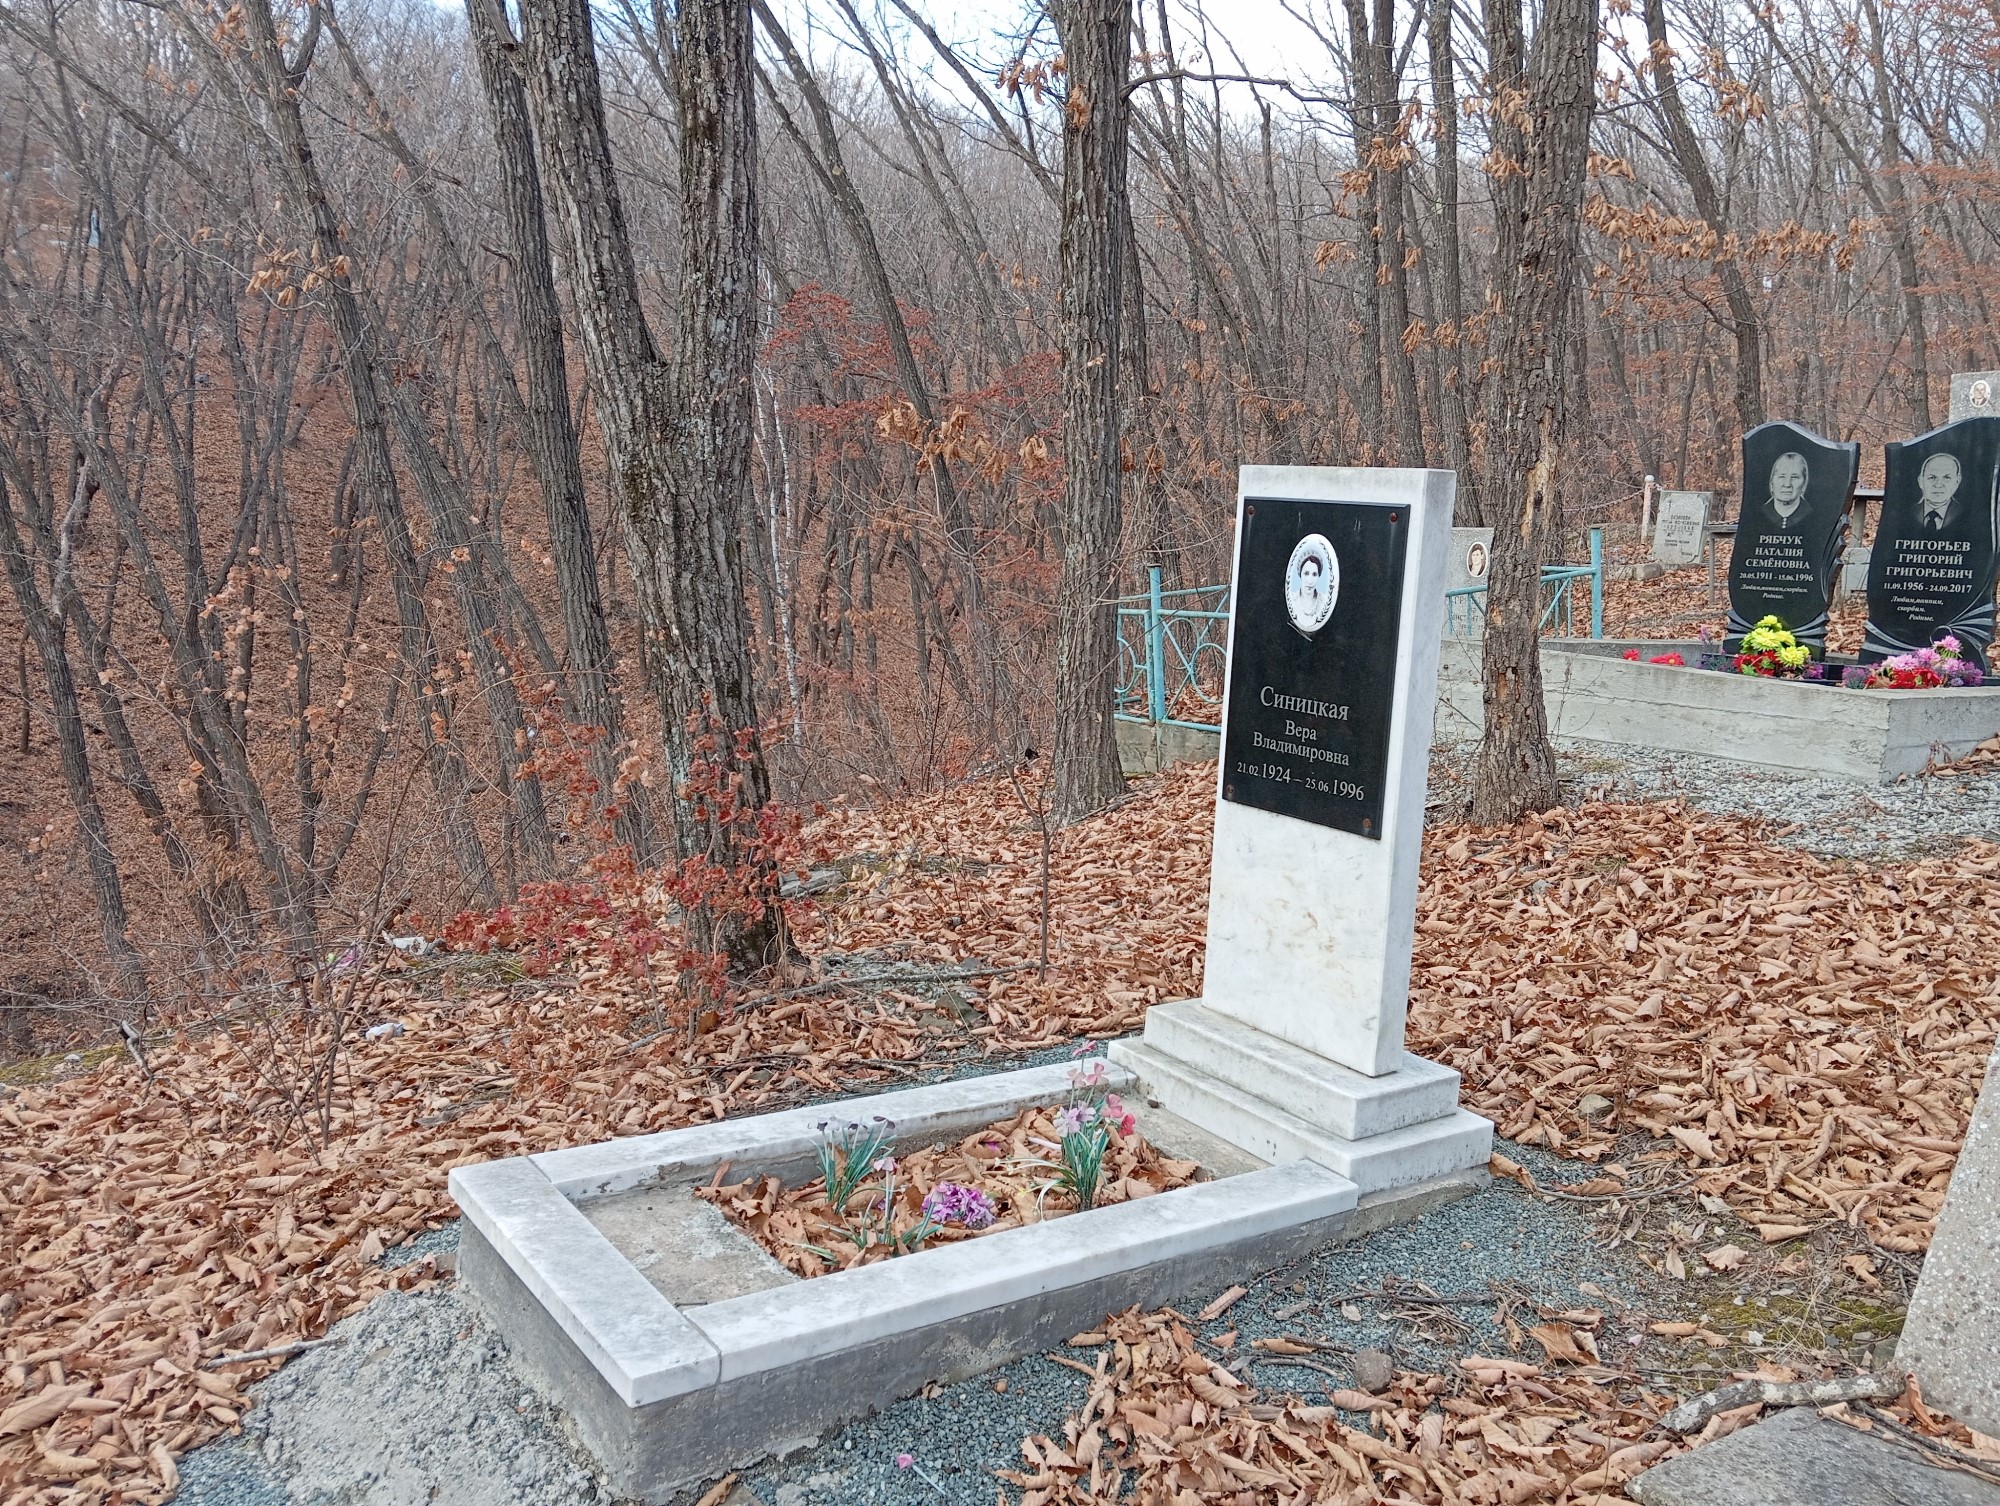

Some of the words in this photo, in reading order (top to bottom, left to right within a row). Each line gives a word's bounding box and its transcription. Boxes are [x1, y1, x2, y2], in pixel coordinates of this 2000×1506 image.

[1759, 535, 1803, 545] РЯБЧУК
[1894, 539, 1971, 552] ГРИГОРЬЕВ
[1755, 547, 1804, 557] НАТАЛИЯ
[1745, 558, 1810, 569] СЕМЁНОВНА
[1898, 553, 1963, 565] ГРИГОРИЙ
[1885, 566, 1973, 579] ГРИГОРЬЕВИЧ
[1883, 582, 1924, 591] 11.09.1956
[1929, 584, 1973, 593] 24.09.2017
[1260, 685, 1350, 721] Синицкая
[1285, 719, 1317, 742] Вера
[1252, 731, 1349, 766] Владимировна
[1237, 761, 1291, 784] 21.02.1924
[1305, 777, 1365, 801] 25.06.1996
